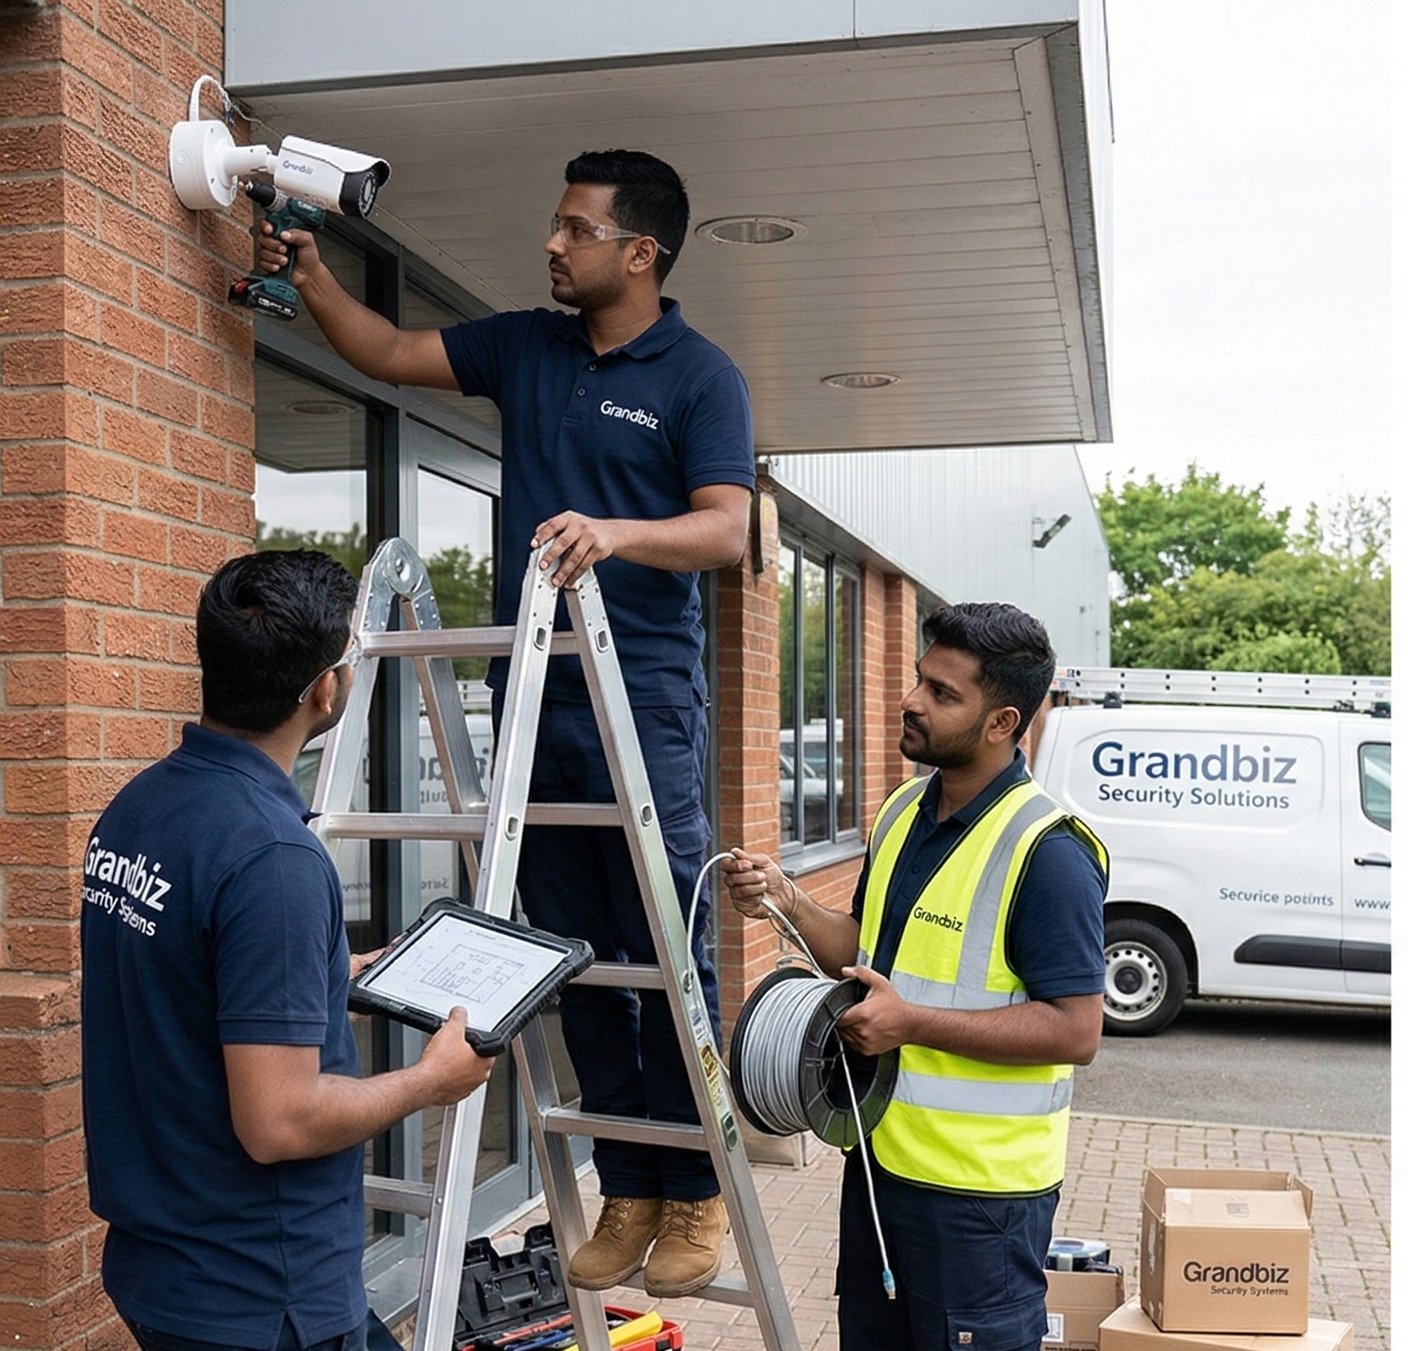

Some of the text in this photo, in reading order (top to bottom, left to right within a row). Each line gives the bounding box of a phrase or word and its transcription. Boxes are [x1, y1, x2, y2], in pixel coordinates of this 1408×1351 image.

[600, 400, 659, 430] Grandbiz
[1092, 741, 1297, 784] Grandbiz
[1098, 783, 1290, 809] Security Solutions
[84, 836, 172, 912] Grandbiz
[913, 906, 963, 932] Grandbiz
[1183, 1261, 1290, 1284] Grandbiz
